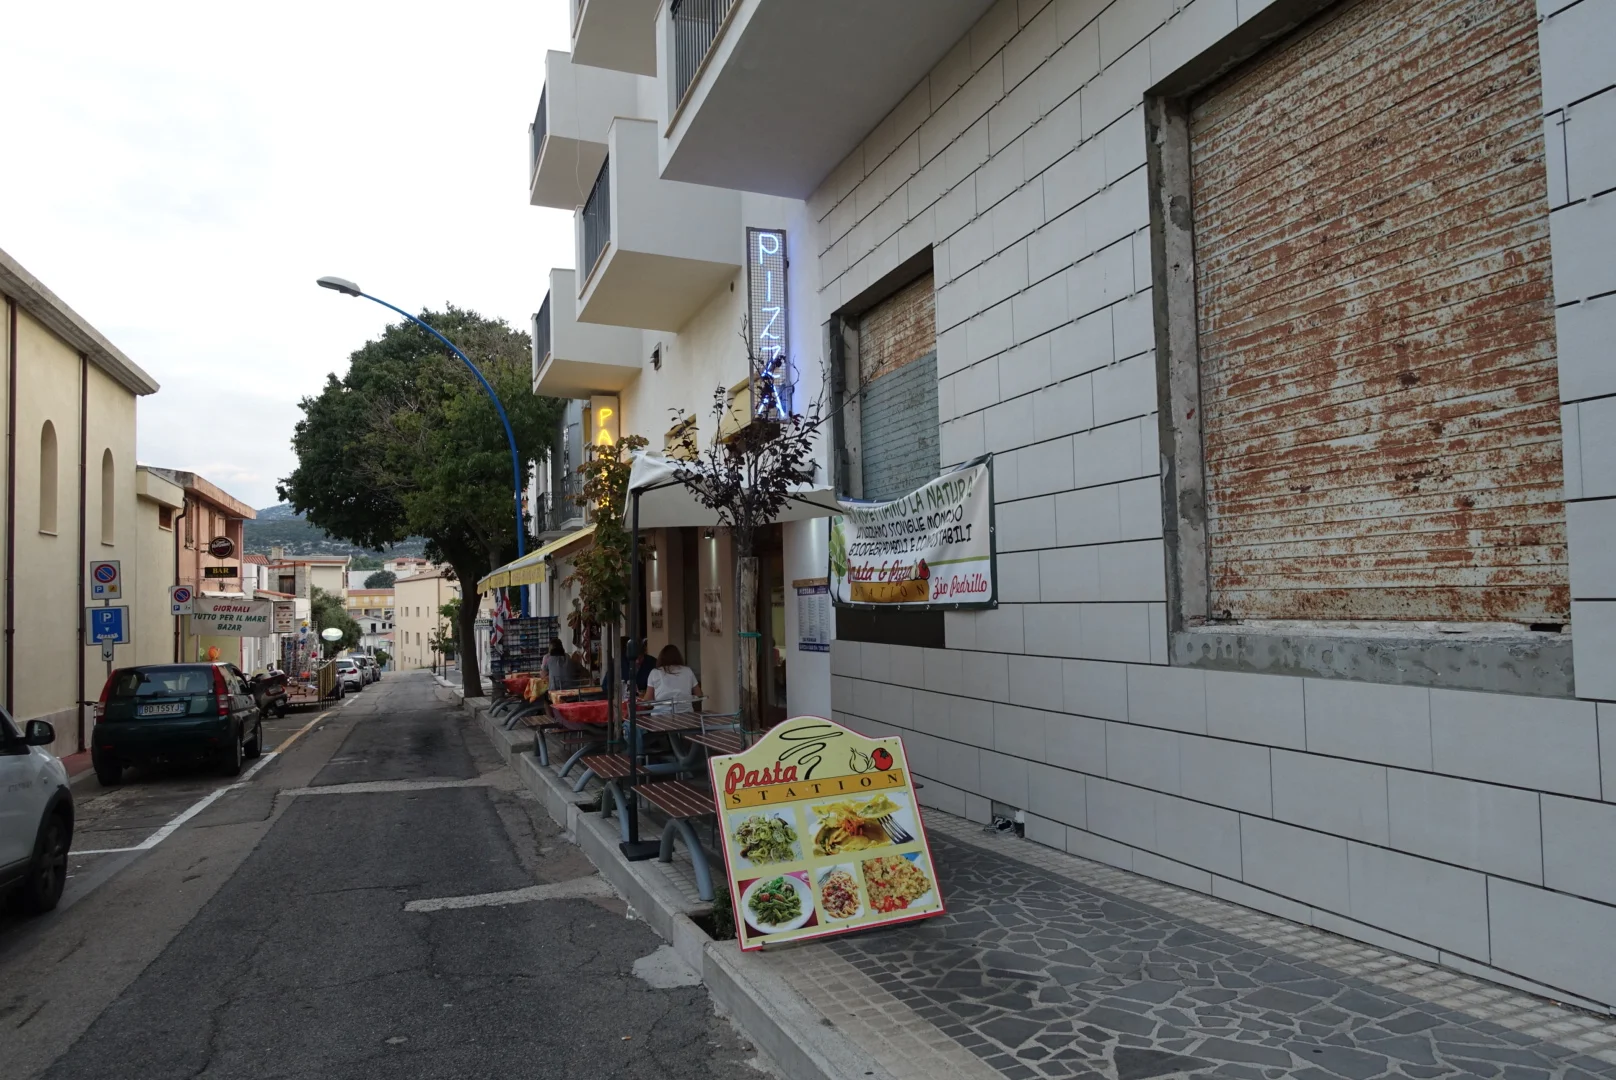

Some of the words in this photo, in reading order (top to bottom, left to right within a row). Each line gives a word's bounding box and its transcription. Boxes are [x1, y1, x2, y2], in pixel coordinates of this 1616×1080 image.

[757, 232, 786, 418] PIZZA
[908, 491, 925, 514] LA
[888, 515, 926, 536] STOVIGLIE
[909, 537, 916, 553] E
[878, 559, 888, 582] &
[854, 583, 926, 598] STATION
[932, 576, 948, 600] Zio
[949, 573, 988, 598] Pedrillo
[102, 612, 112, 623] P
[193, 612, 217, 621] TUTTO
[219, 613, 235, 622] PER
[236, 614, 243, 622] IL
[244, 615, 268, 623] MARE
[213, 604, 251, 613] GIORNALI
[217, 623, 243, 632] BAZAR
[724, 760, 799, 795] Pasta
[731, 772, 900, 805] STATION
